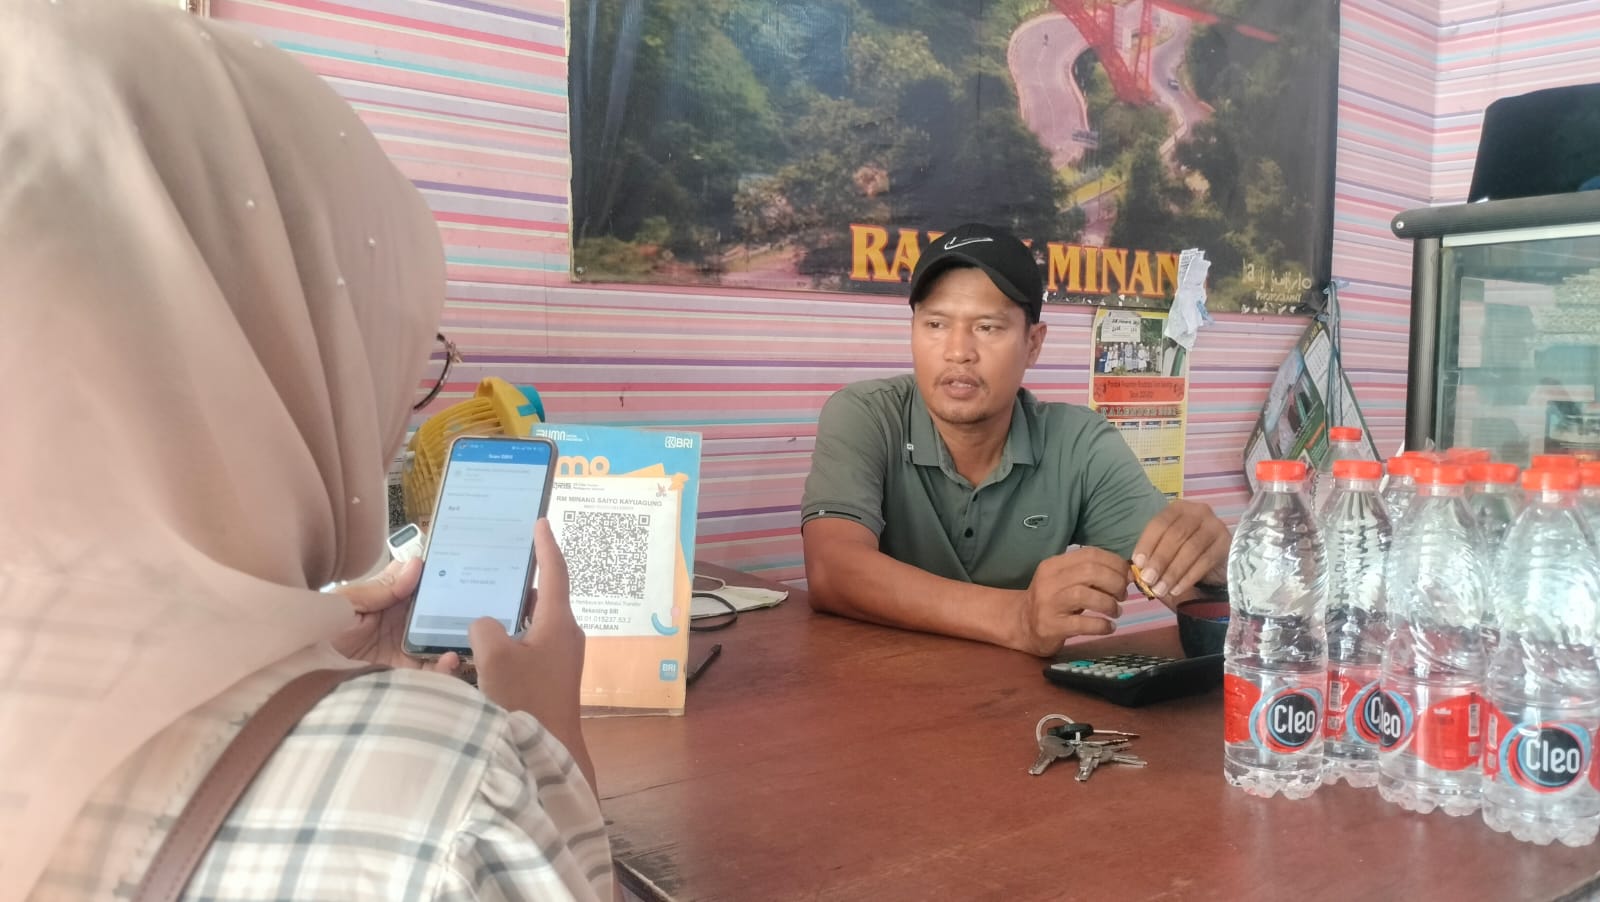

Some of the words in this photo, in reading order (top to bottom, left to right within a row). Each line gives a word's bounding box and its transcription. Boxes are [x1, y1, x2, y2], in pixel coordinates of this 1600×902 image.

[1047, 242, 1208, 298] MINAN
[676, 438, 694, 449] BRI
[556, 455, 611, 477] mo
[619, 498, 663, 507] KAYUAGUNG
[581, 607, 608, 615] Rekening
[662, 663, 676, 672] BRI
[1274, 704, 1316, 734] Cleo
[1526, 739, 1581, 775] Cleo
